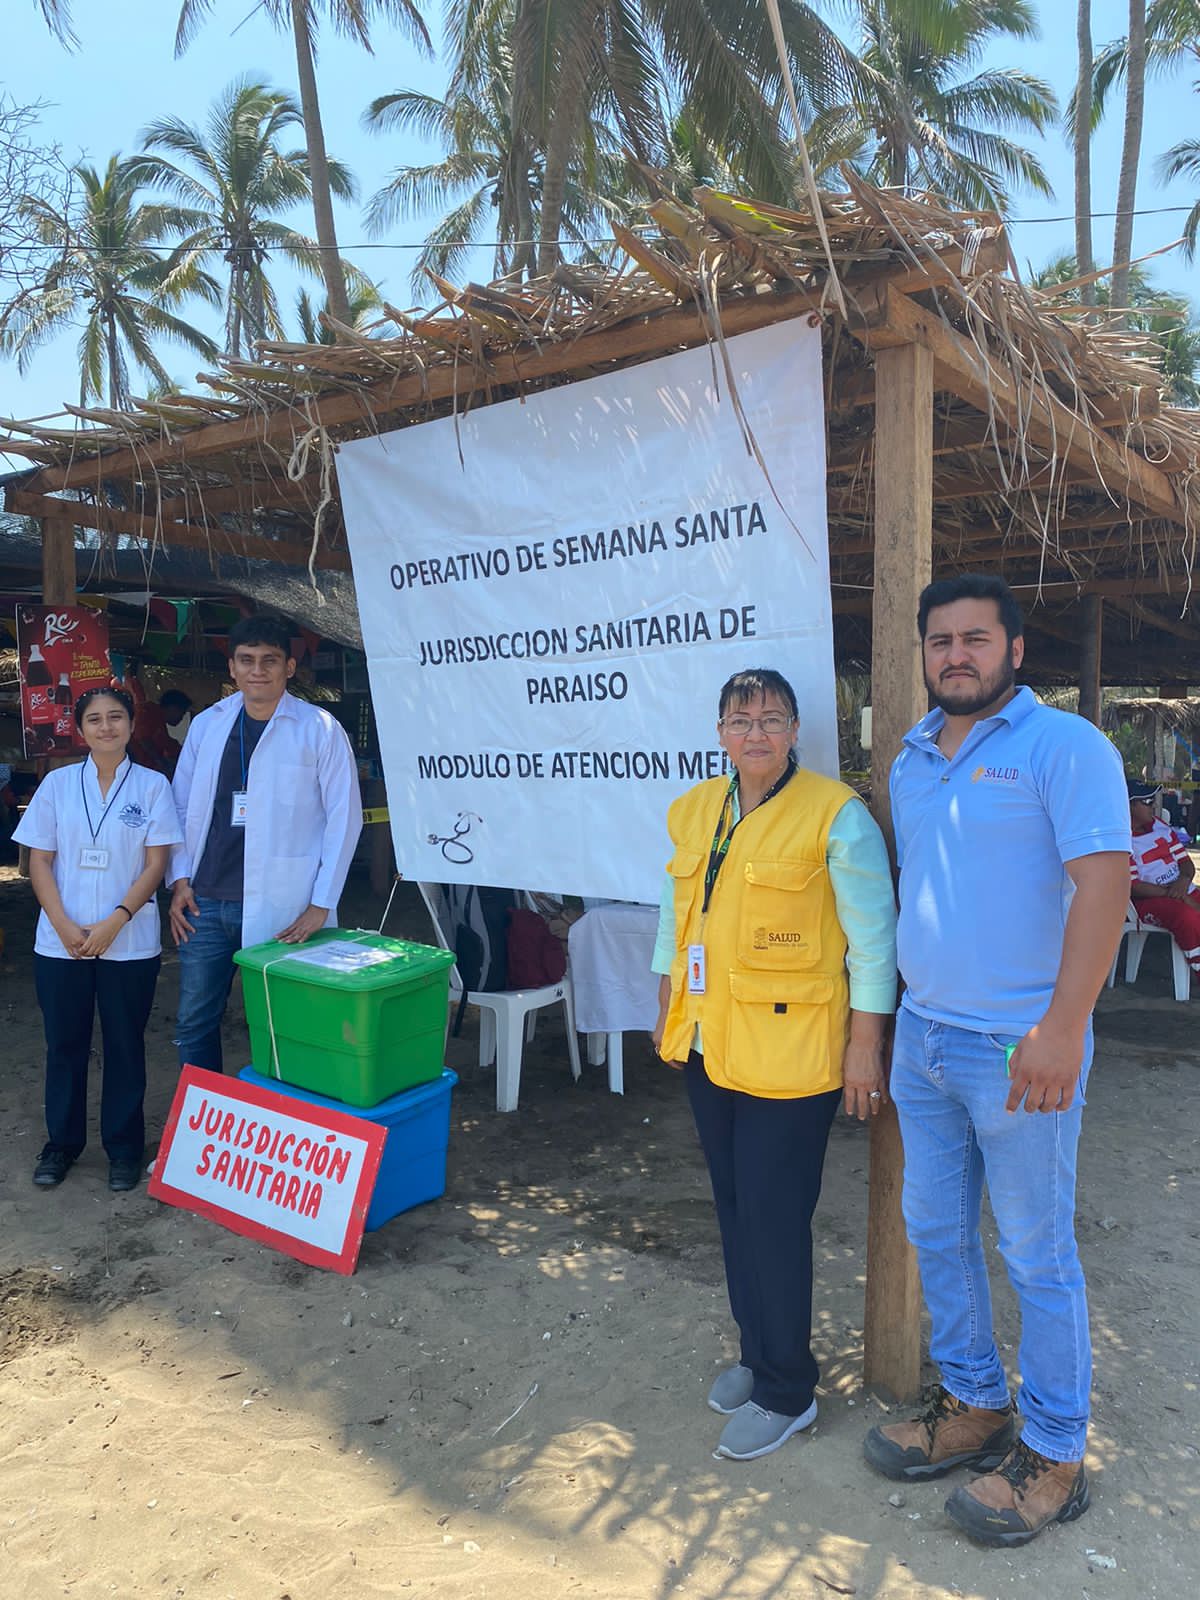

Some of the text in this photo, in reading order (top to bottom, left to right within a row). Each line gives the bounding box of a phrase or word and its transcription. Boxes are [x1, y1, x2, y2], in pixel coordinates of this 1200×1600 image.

[390, 502, 767, 590] OPERATIVO DE SEMANA SANTA
[44, 613, 78, 644] RC
[419, 605, 756, 667] JURISDICCION SANITARIA DE
[526, 671, 628, 705] PARAISO
[418, 753, 510, 780] MODULO
[516, 753, 544, 779] DE
[551, 752, 669, 780] ATENCION
[984, 767, 1019, 780] SALUD
[768, 932, 801, 942] SALUD
[188, 1099, 352, 1185] JURISDICCIÓN
[196, 1144, 323, 1219] SANITARIA
